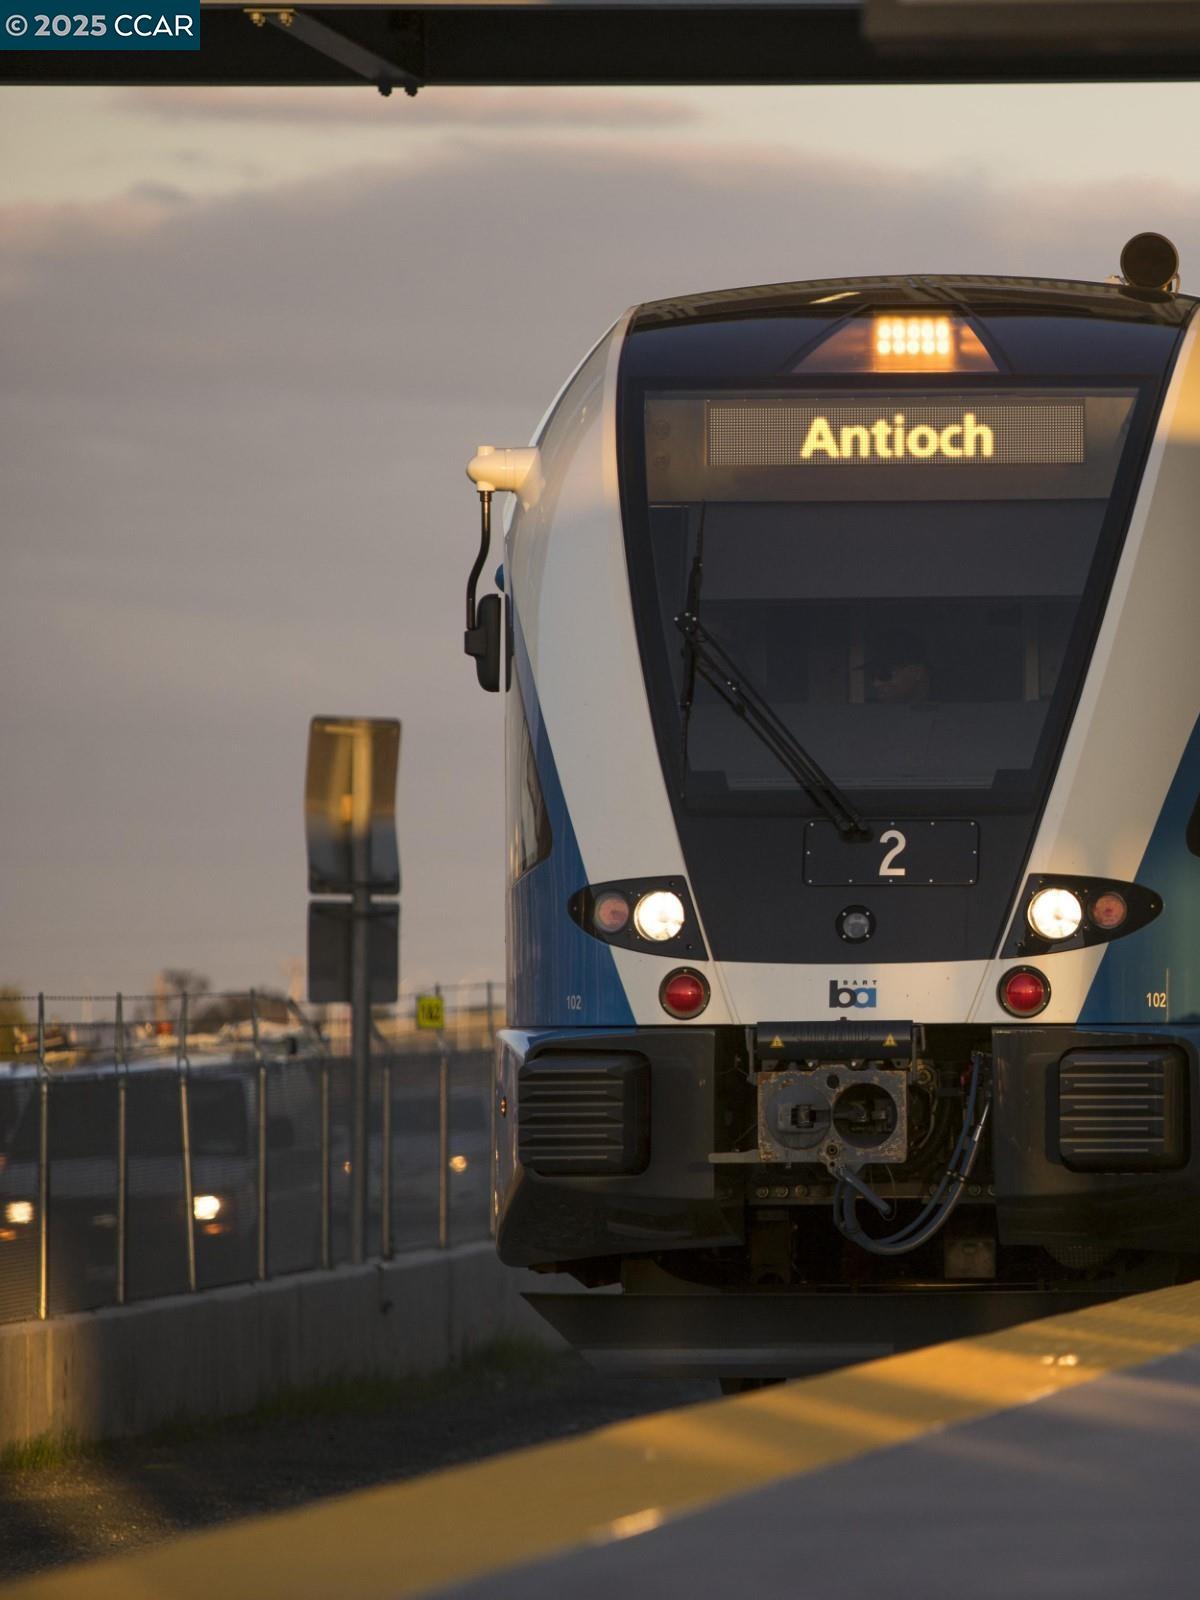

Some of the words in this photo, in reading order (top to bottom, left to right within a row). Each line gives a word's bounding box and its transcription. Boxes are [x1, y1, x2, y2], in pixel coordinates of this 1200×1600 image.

[801, 412, 995, 459] Antioch
[878, 829, 907, 876] 2
[566, 994, 582, 1010] 102
[1146, 992, 1167, 1008] 102
